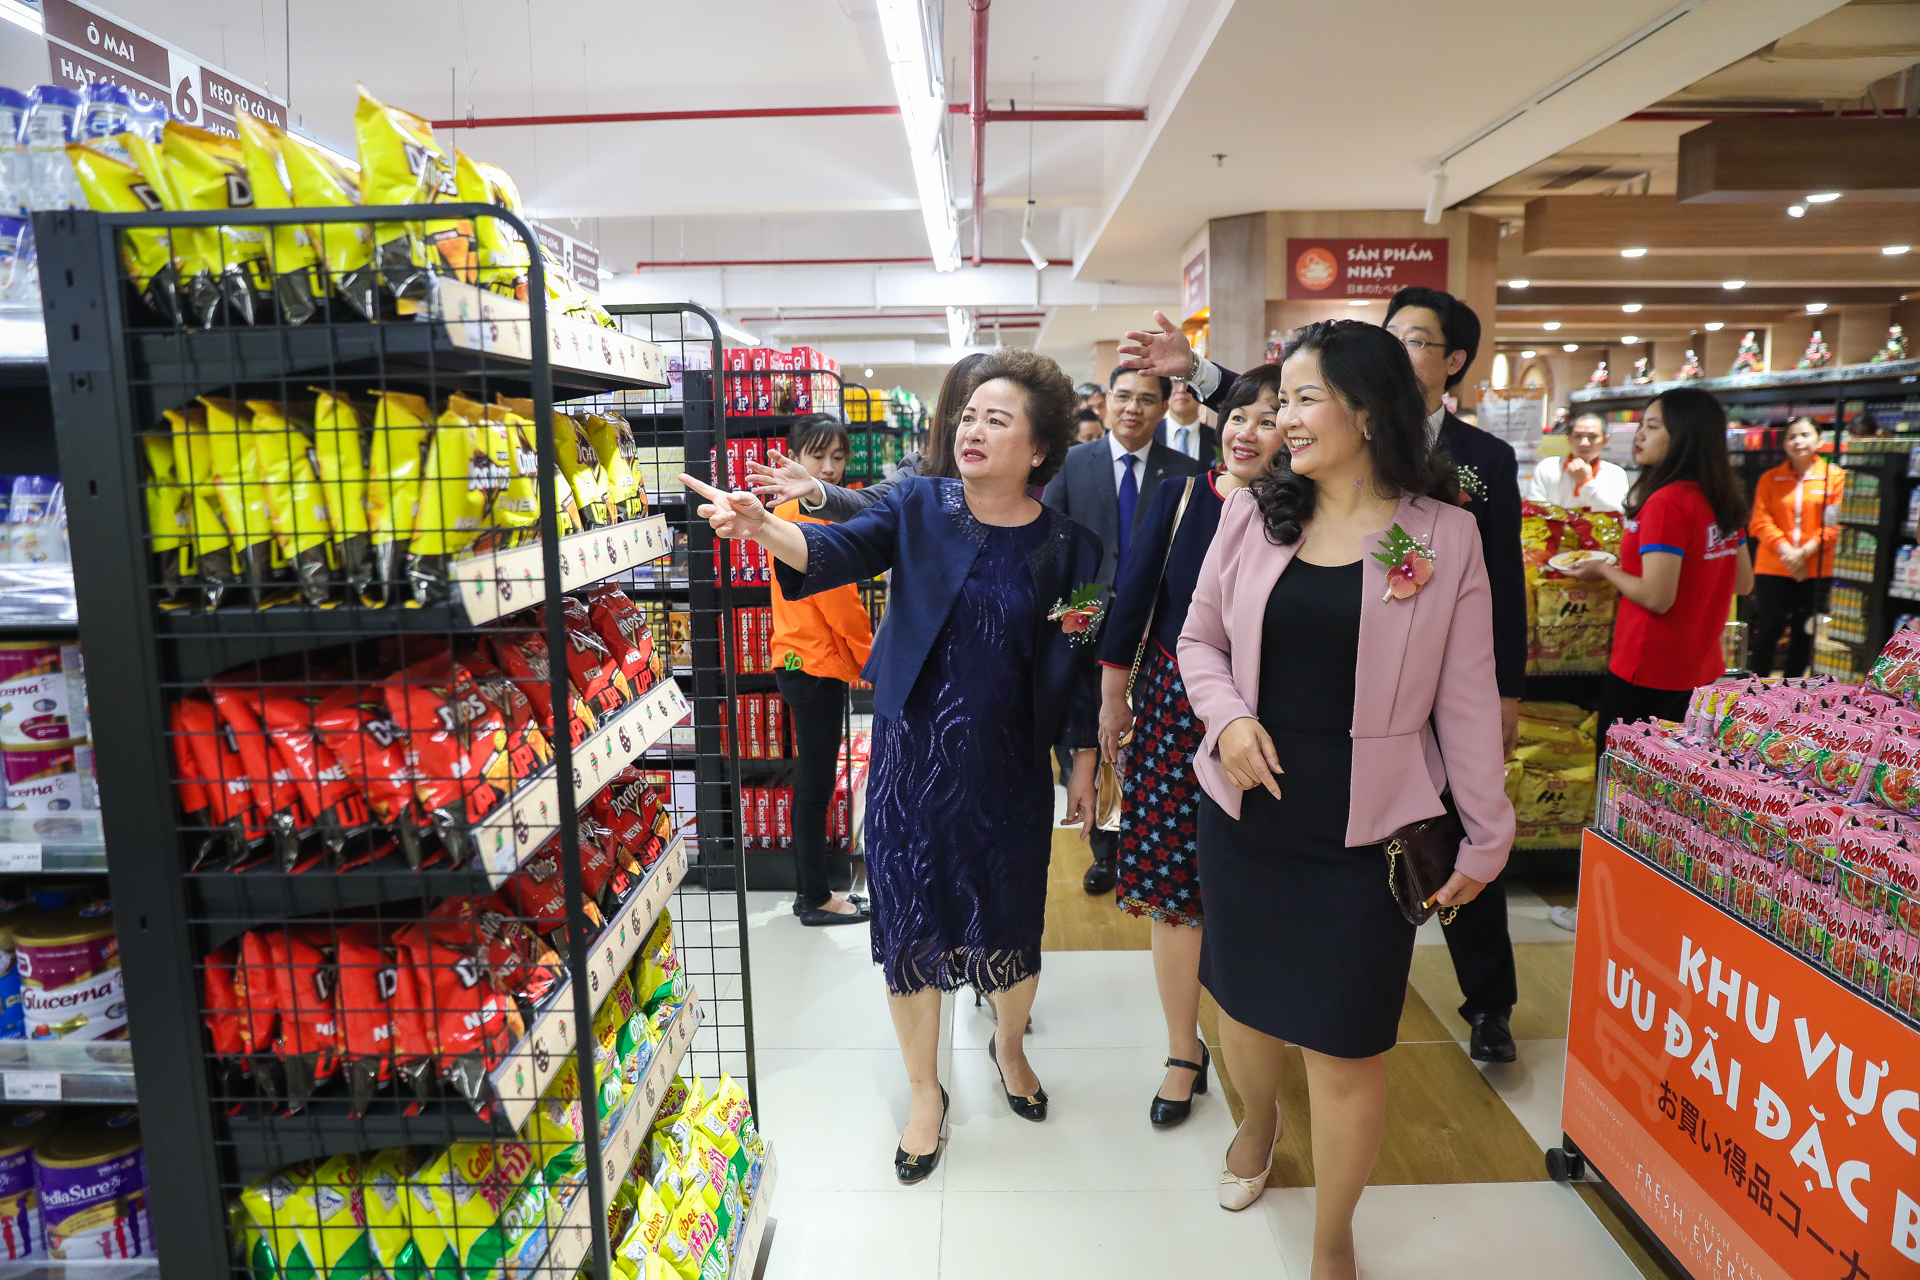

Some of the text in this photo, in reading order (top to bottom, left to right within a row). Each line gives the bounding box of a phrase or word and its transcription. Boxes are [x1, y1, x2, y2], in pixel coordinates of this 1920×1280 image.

[87, 21, 135, 62] Ô MAI
[176, 75, 199, 123] 6
[209, 80, 233, 107] KẸO
[250, 101, 266, 118] CÔ
[266, 109, 281, 128] LA
[566, 251, 571, 273] 5
[1347, 243, 1434, 261] SẢN PHẨM
[1347, 263, 1395, 281] NHẬT
[583, 666, 604, 683] NEW
[1648, 751, 1672, 776] Hảo
[1880, 743, 1908, 768] Hảo
[1684, 765, 1707, 788] Hảo
[610, 775, 649, 819] Doritos
[1763, 794, 1790, 818] Hảo
[757, 799, 766, 834] Choco-Pie
[1805, 811, 1834, 838] Hảo
[622, 822, 643, 843] NEW
[1840, 838, 1870, 865] Hảo
[1888, 861, 1920, 893] Hảo
[1849, 919, 1881, 950] Hảo
[25, 982, 113, 1010] Glucerna
[1678, 935, 1920, 1157] KHU VỰC
[1607, 958, 1656, 1032] ƯU
[1664, 1007, 1742, 1112] ĐÃI
[1753, 1081, 1871, 1225] ĐẶC
[717, 1097, 737, 1122] Calbee
[1638, 1163, 1684, 1226] FRESH
[679, 1208, 699, 1242] Calbee
[1699, 1213, 1730, 1253] FRESH
